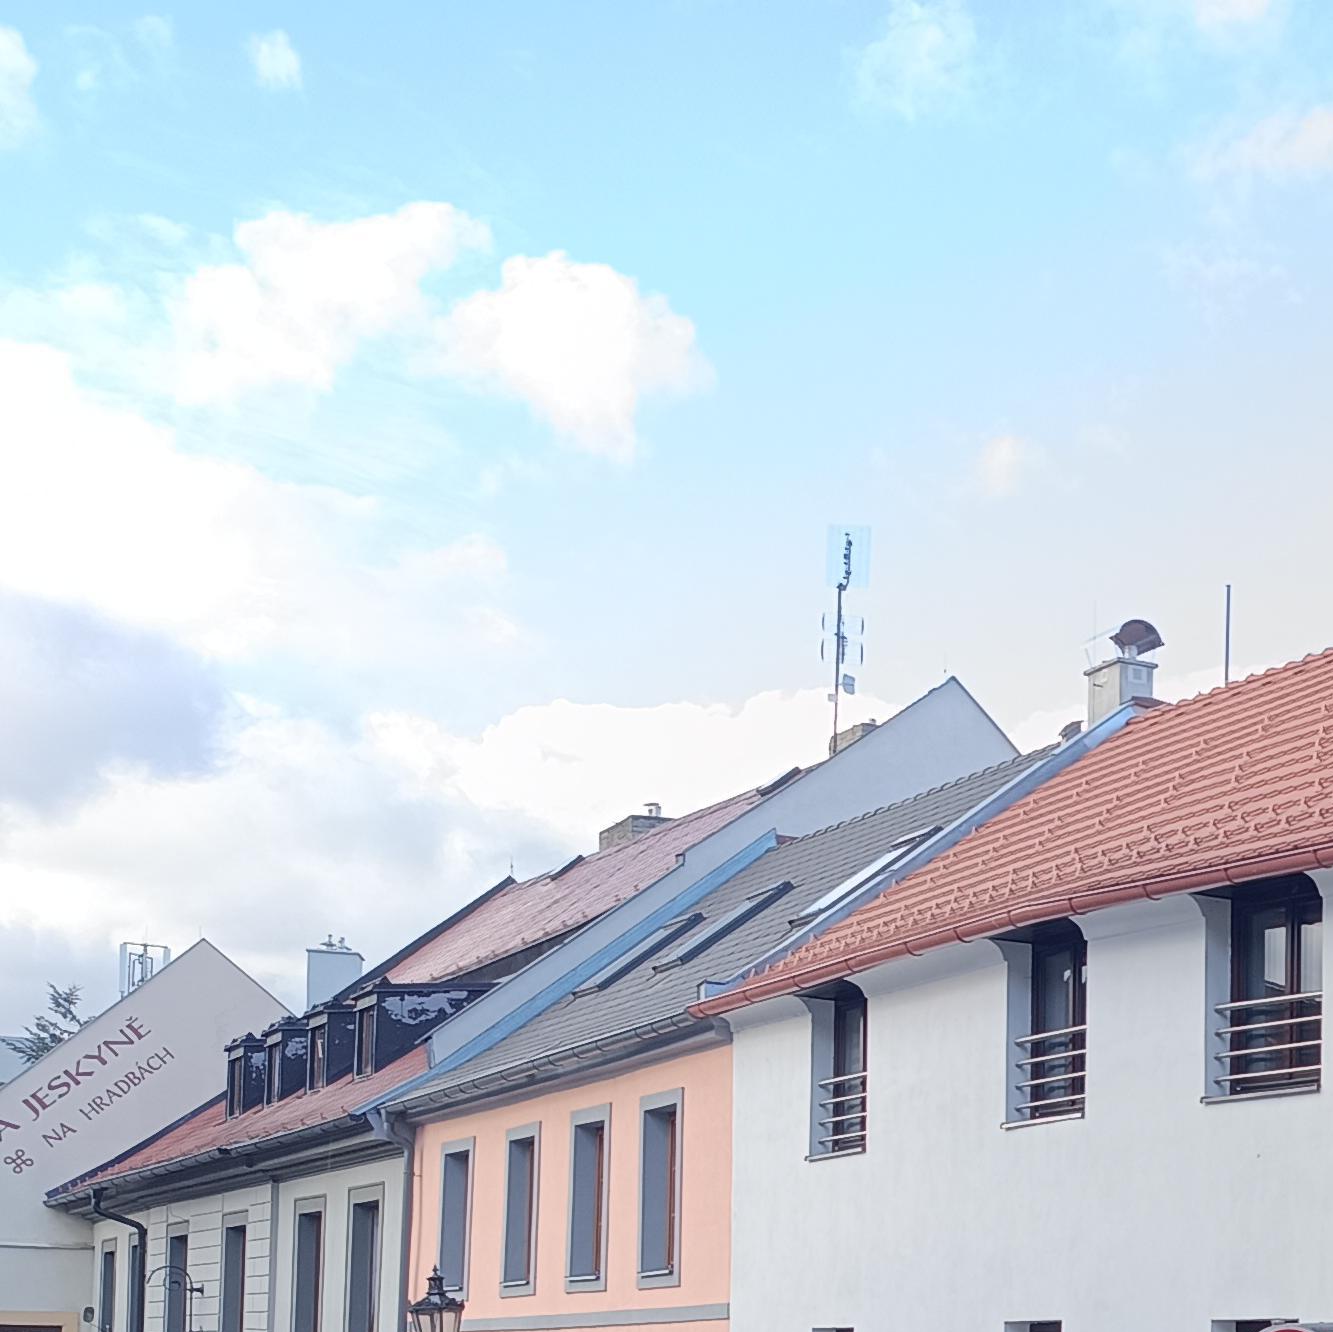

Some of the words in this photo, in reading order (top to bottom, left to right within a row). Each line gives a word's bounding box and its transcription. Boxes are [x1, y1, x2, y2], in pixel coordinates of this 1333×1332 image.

[21, 1016, 151, 1121] JESKYNĚ
[42, 1122, 77, 1148] NA
[79, 1047, 175, 1120] HRADBÁCH
